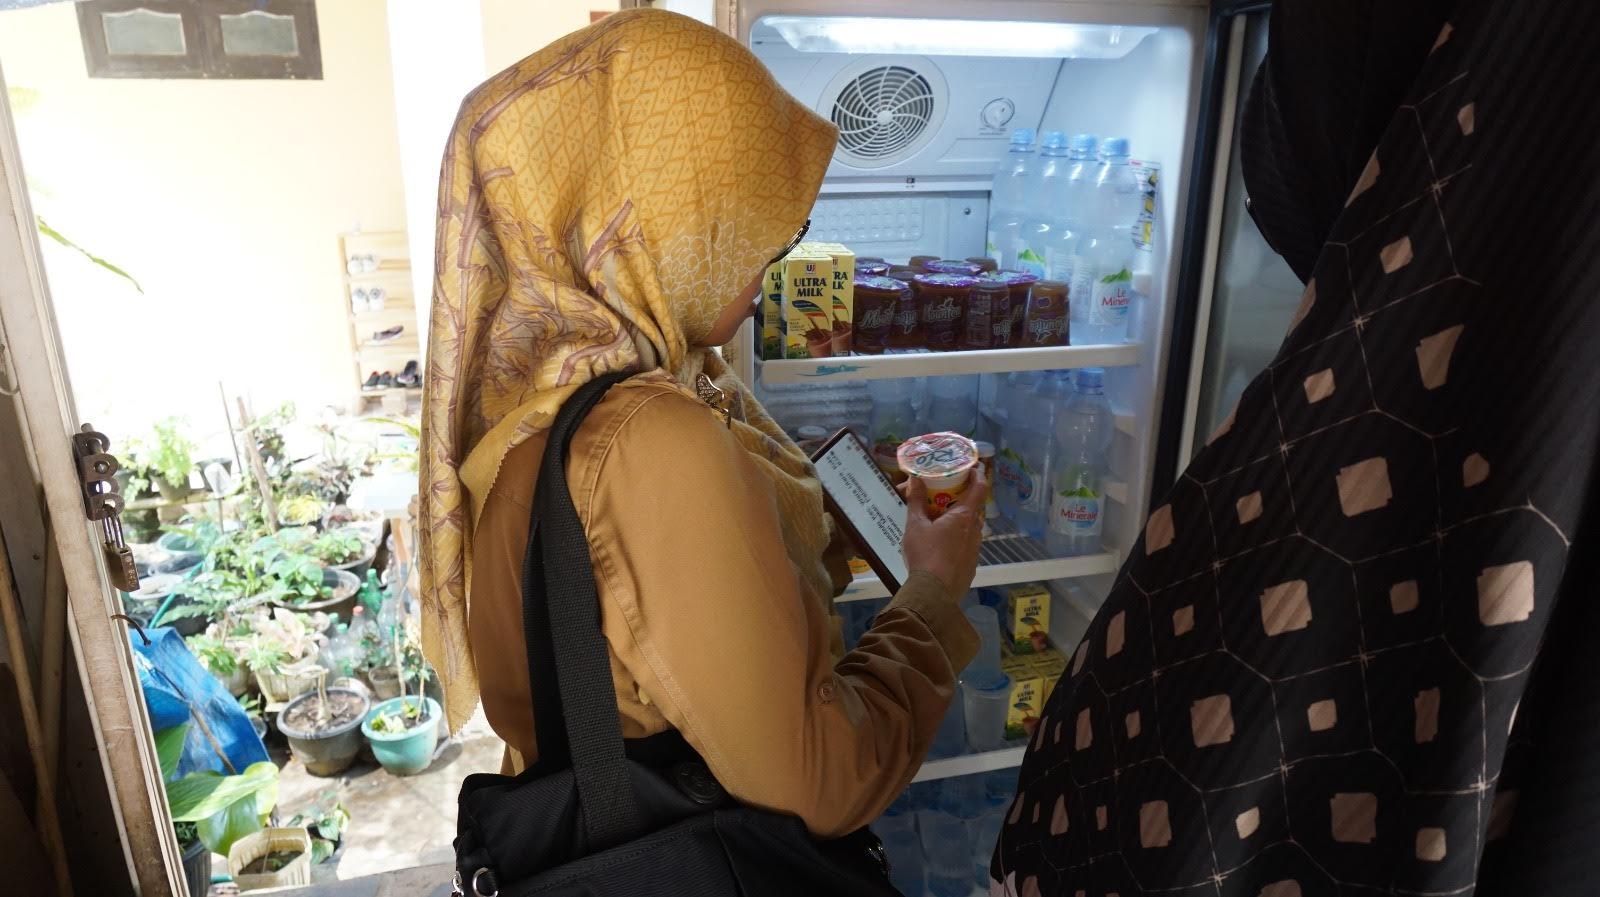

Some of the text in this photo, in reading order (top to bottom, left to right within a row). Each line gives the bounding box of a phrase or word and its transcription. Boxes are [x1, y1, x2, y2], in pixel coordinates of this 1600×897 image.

[793, 277, 828, 287] ULTRA
[796, 287, 824, 298] MILK
[1075, 503, 1086, 512] Le
